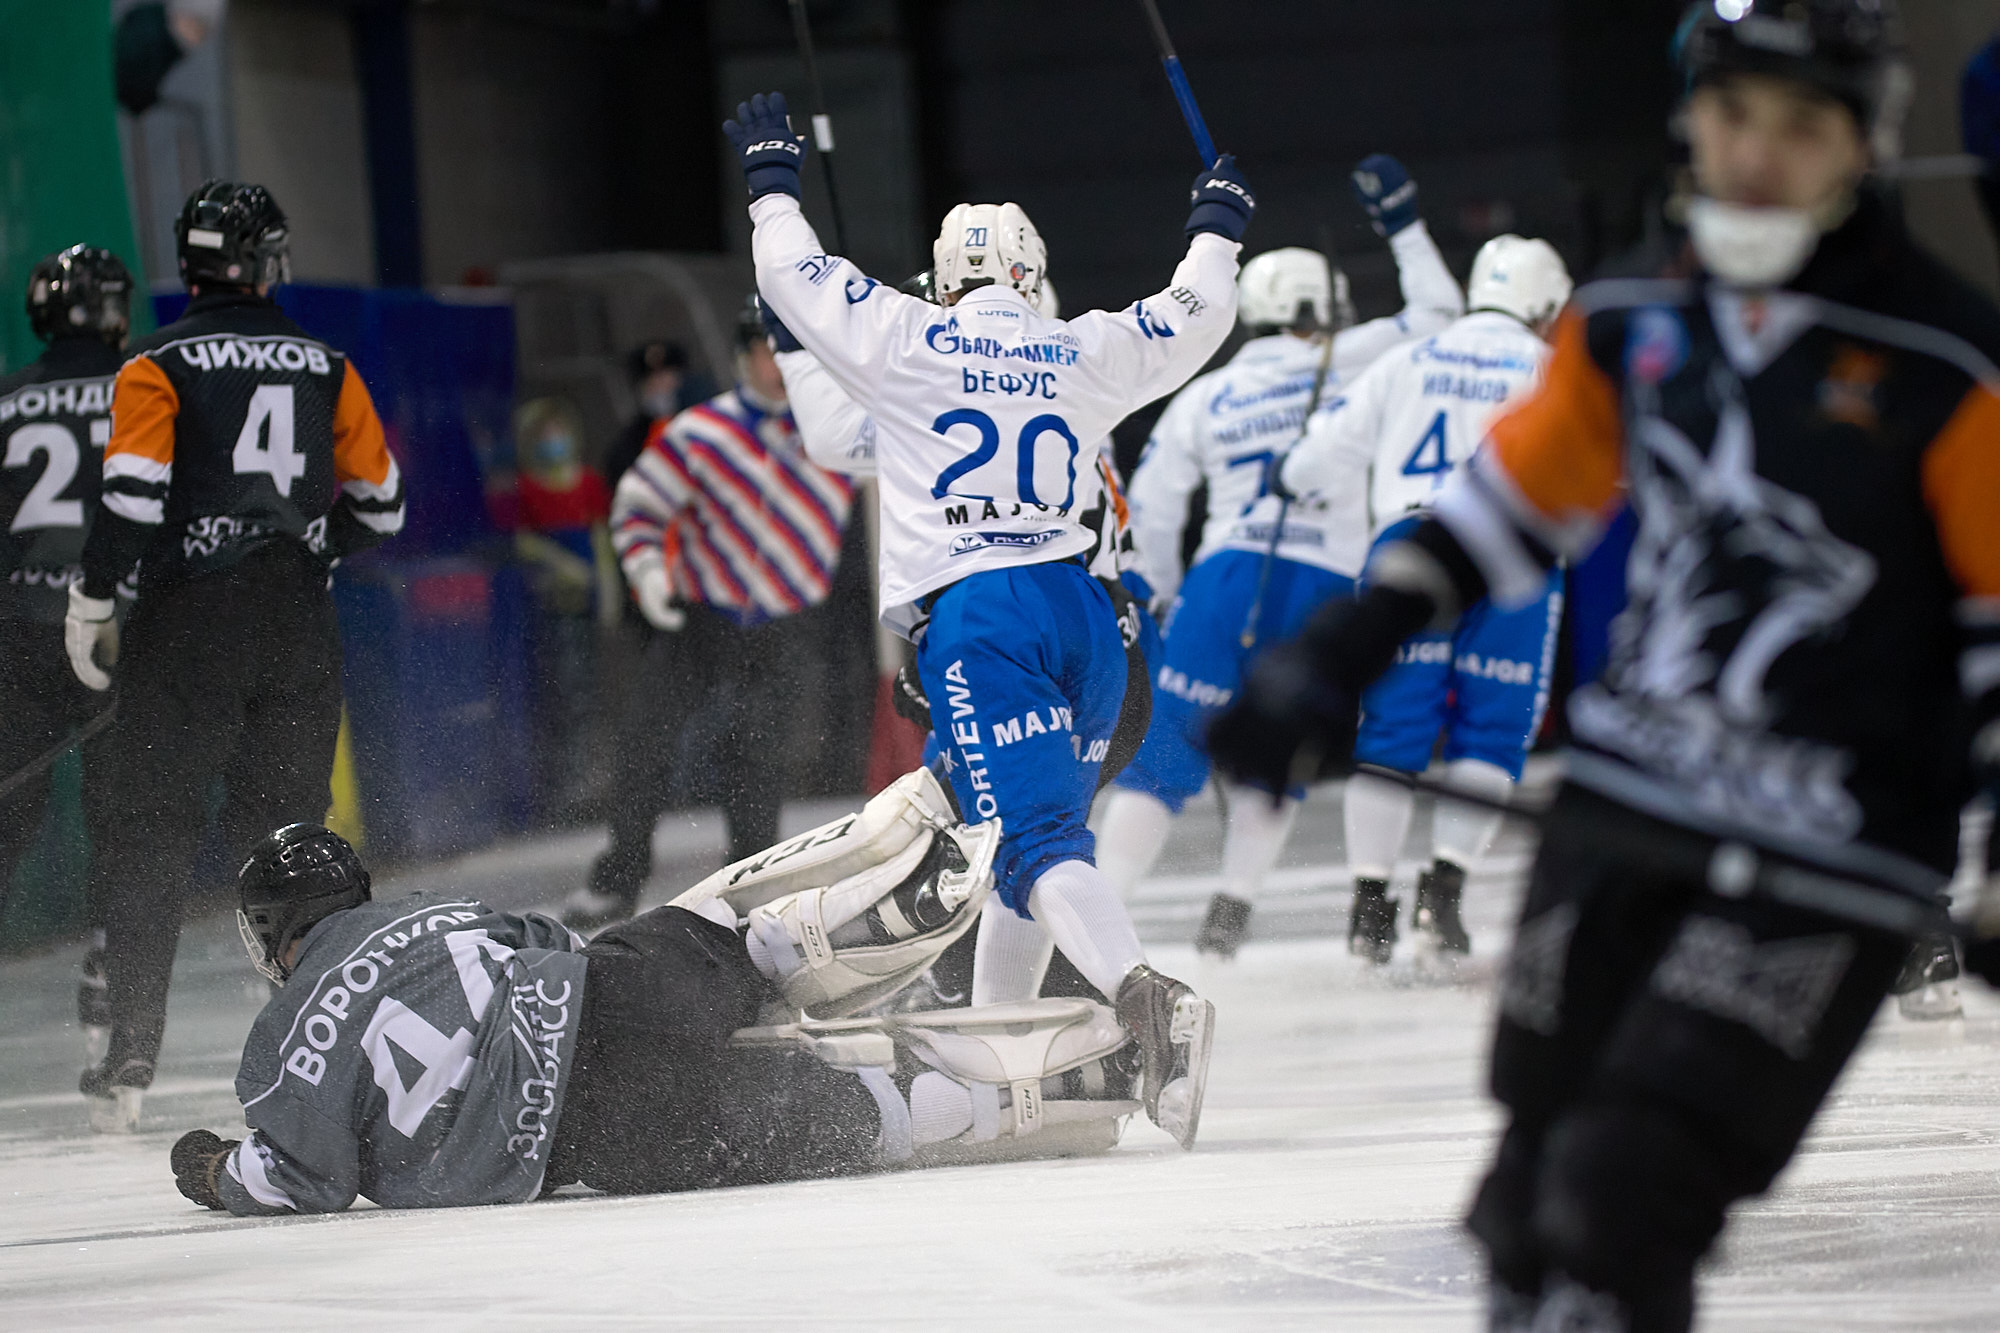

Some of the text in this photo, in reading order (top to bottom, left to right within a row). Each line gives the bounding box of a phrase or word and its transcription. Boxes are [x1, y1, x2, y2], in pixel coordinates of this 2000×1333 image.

[745, 140, 801, 156] CCM
[1204, 178, 1256, 209] CCM
[965, 227, 988, 247] 20
[976, 309, 1020, 319] LUTCH
[179, 339, 330, 375] ЧИЖОВ
[963, 366, 1057, 400] БЕФУС
[232, 384, 307, 499] 4
[1401, 408, 1455, 490] 4
[2, 417, 112, 535] 2
[930, 408, 1079, 512] 20
[945, 659, 999, 819] ORTEWA
[807, 924, 823, 958] CCM
[1023, 1088, 1034, 1119] CCM
